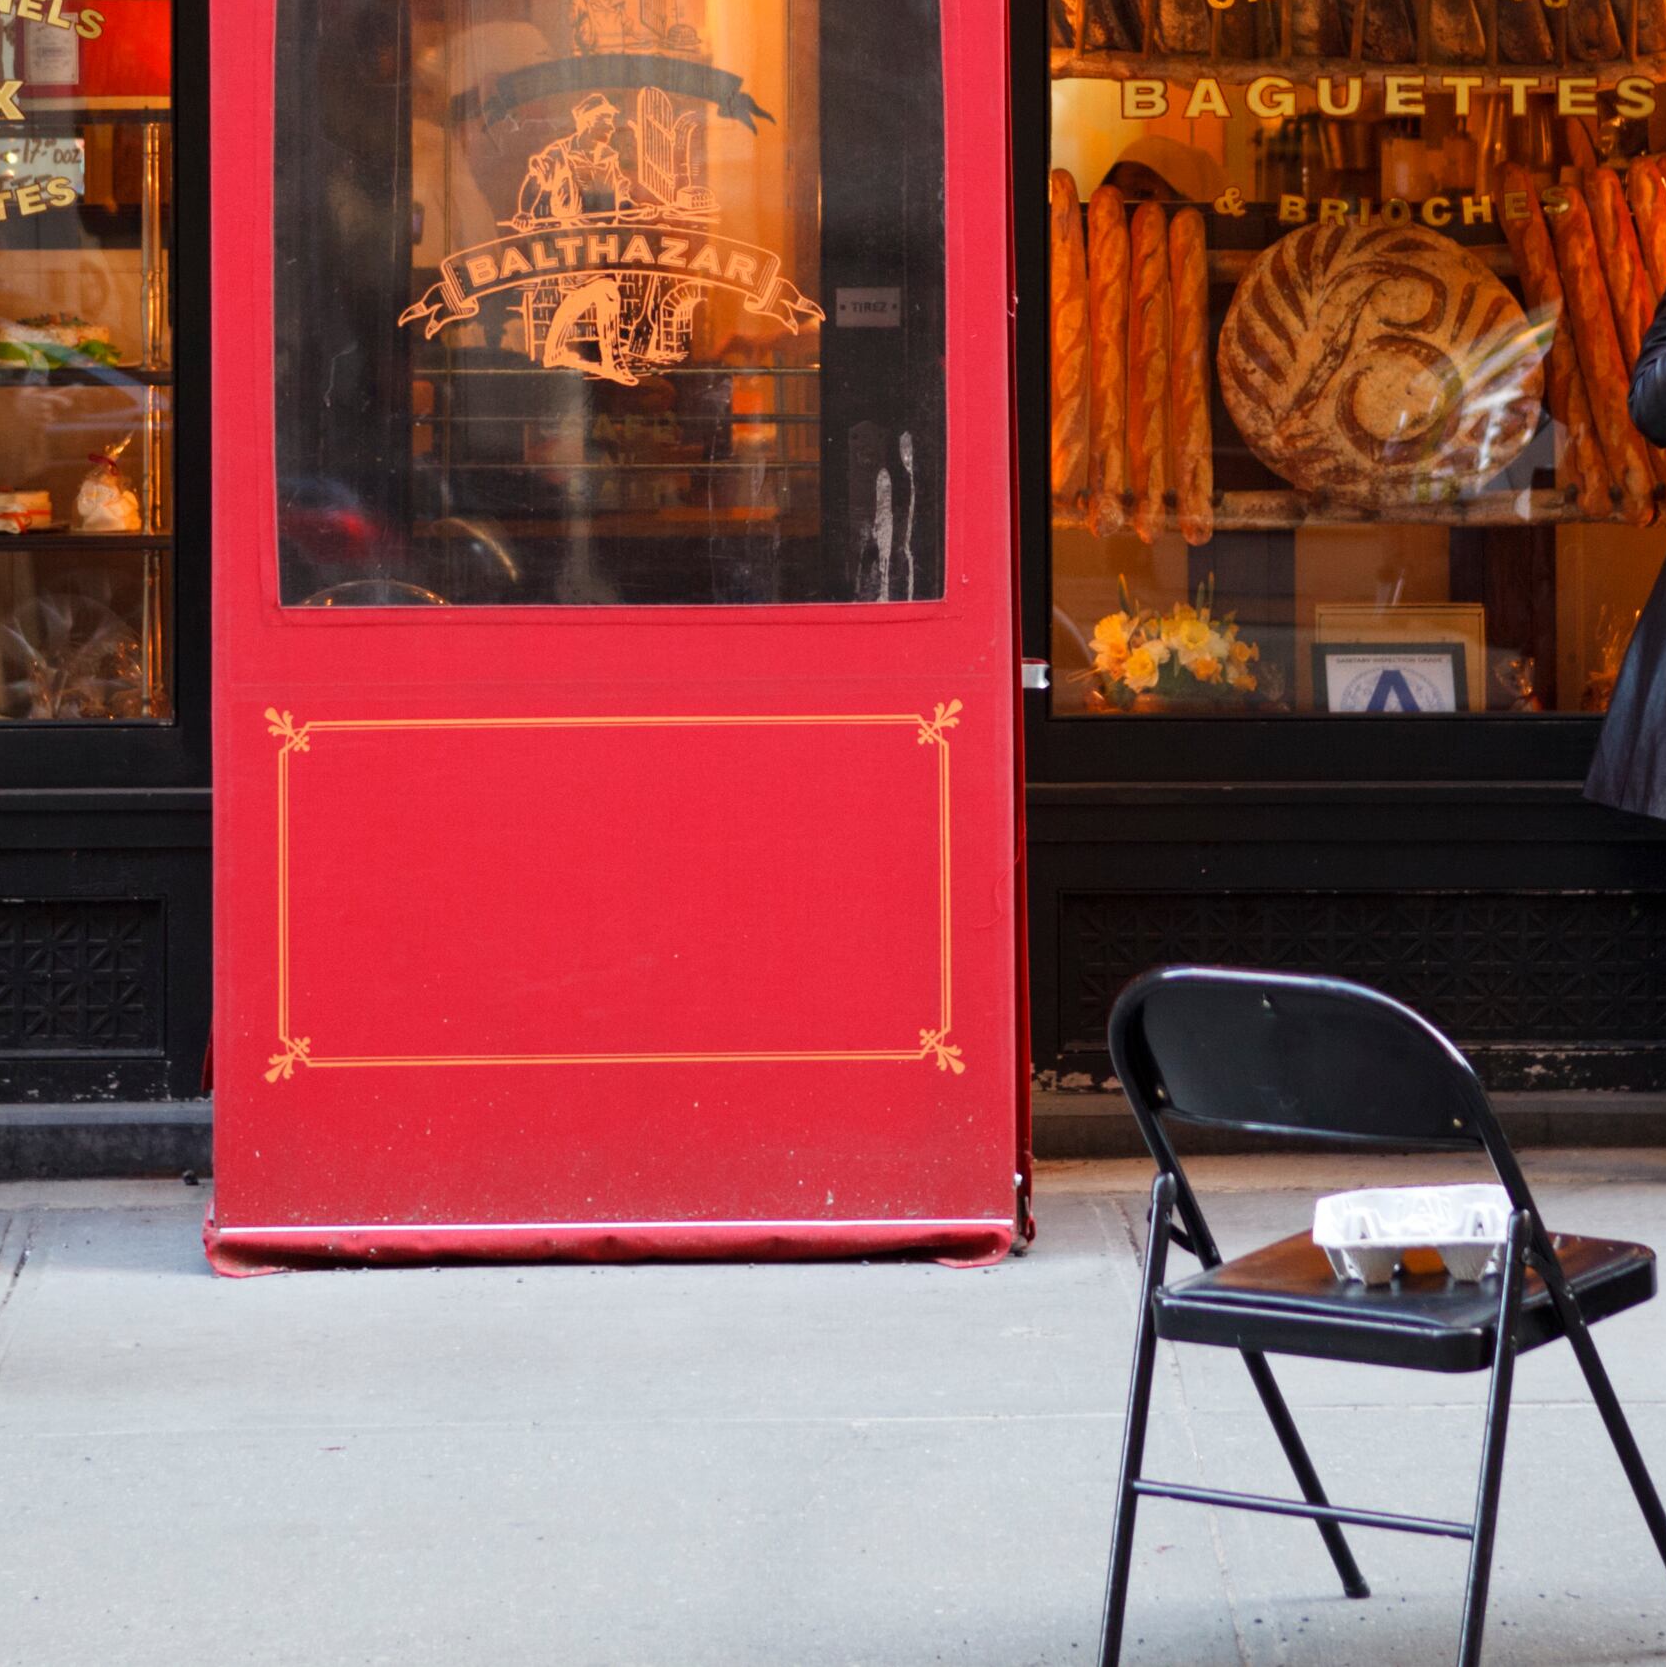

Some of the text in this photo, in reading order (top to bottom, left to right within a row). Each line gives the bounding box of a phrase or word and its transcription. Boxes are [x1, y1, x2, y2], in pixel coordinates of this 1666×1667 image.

[1120, 74, 1659, 120] BAGUETTES
[1214, 183, 1573, 228] & BRIOCHES
[466, 234, 758, 287] BALTHAZAR
[851, 301, 887, 313] TIREZ
[1336, 656, 1371, 664] SANITARY
[1366, 670, 1421, 712] A
